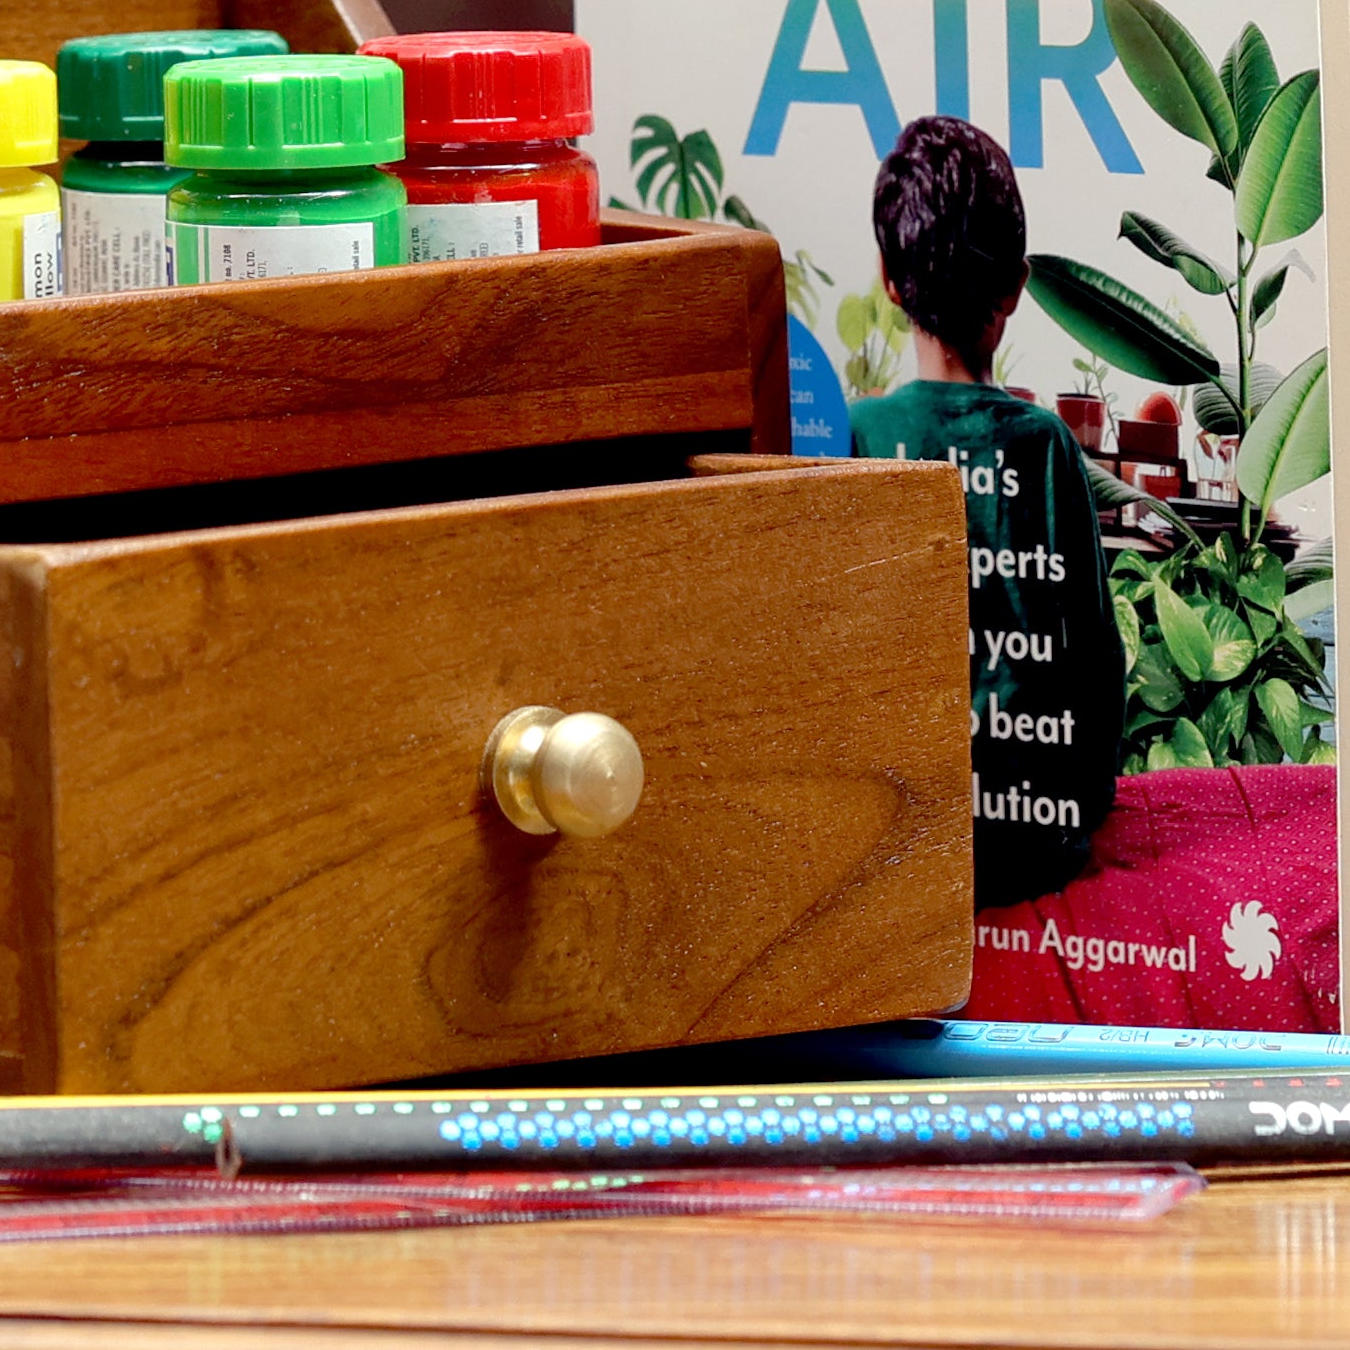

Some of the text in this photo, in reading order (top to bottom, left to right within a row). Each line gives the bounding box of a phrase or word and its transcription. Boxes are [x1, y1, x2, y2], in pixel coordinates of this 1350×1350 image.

[34, 252, 43, 298] mon
[45, 252, 53, 296] llow
[246, 249, 256, 267] LTD.
[791, 416, 833, 438] hable
[968, 543, 1066, 588] perts
[984, 629, 1053, 671] you
[988, 691, 1075, 745] beat
[972, 771, 1081, 828] lution
[977, 917, 1197, 972] run Aggarwal
[1248, 1100, 1350, 1137] DOM
